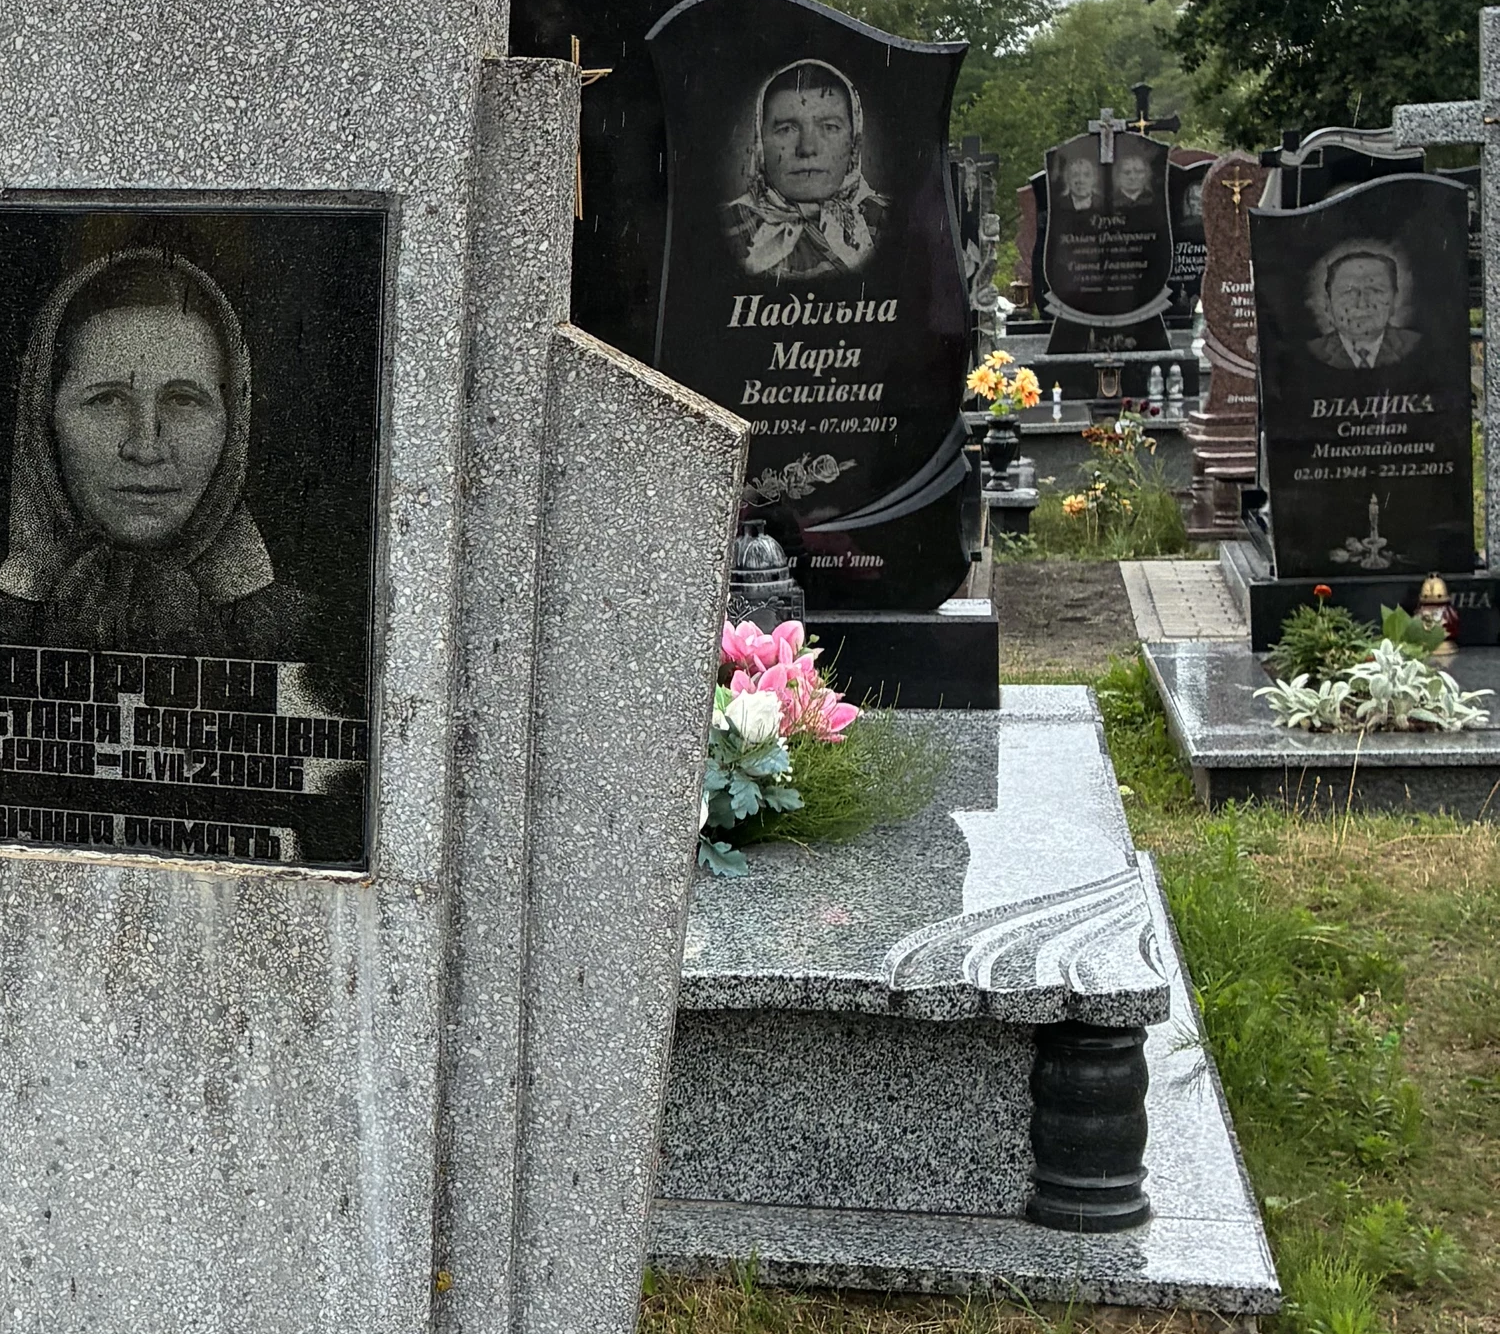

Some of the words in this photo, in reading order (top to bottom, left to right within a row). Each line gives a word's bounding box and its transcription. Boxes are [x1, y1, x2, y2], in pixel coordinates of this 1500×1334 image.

[726, 292, 898, 328] Надільна
[767, 339, 861, 377] Марія
[740, 376, 884, 405] Василівна
[1311, 394, 1434, 418] ВЛАДИКА
[750, 419, 807, 435] 09.1934
[819, 417, 898, 434] 07.09.2019
[1337, 423, 1408, 438] Степан
[1311, 441, 1436, 458] Миколайович
[134, 707, 367, 761] ВАСИЛІВНА
